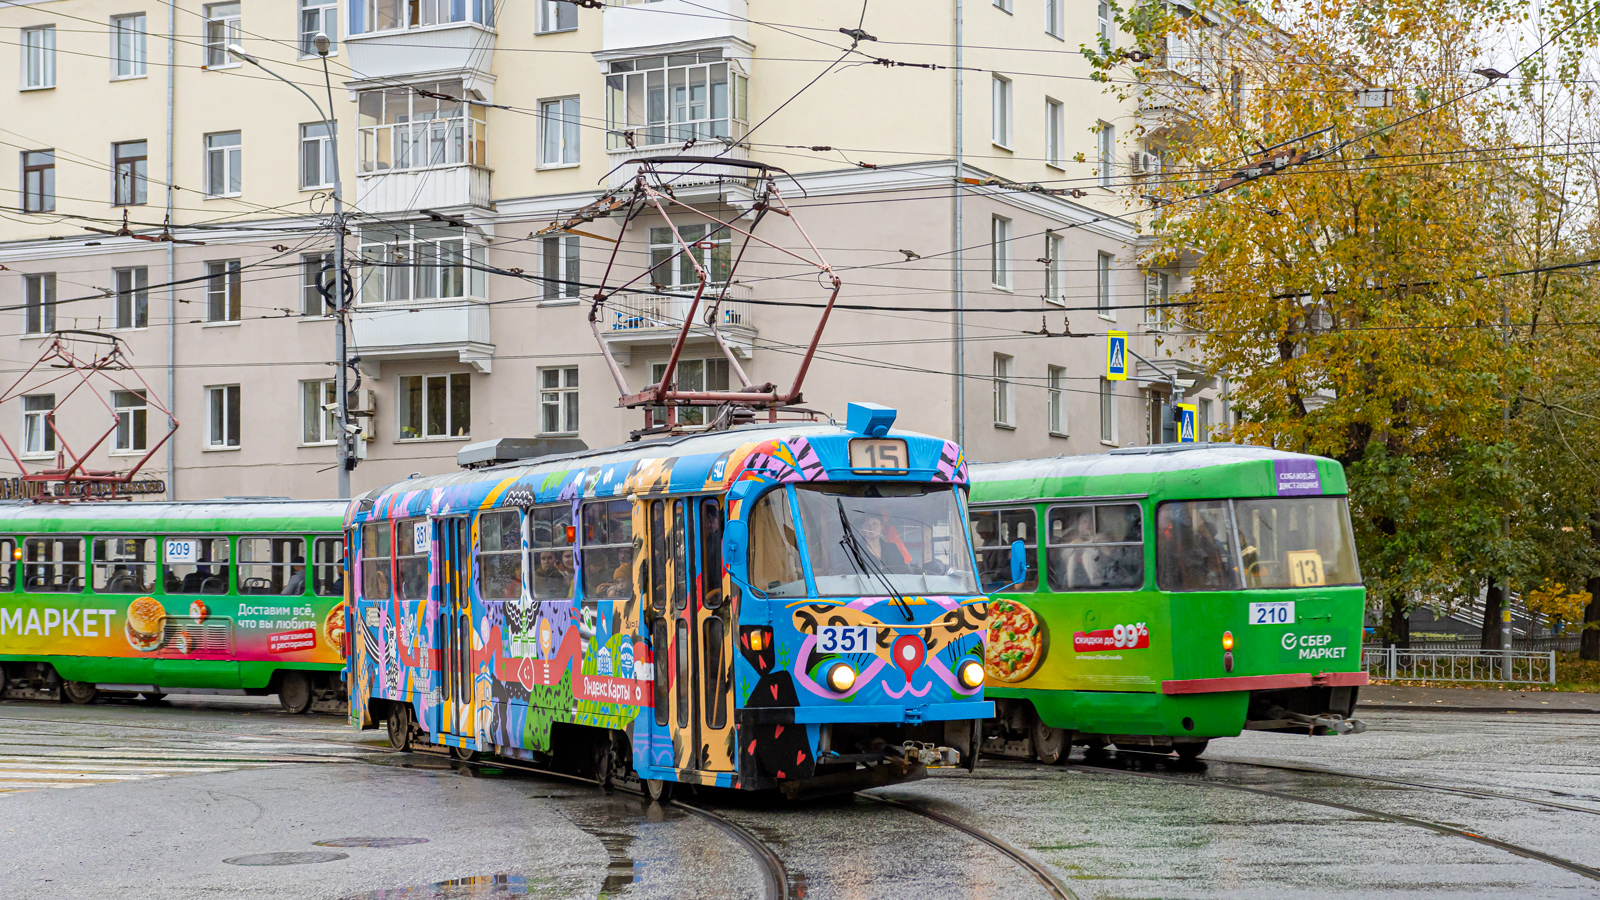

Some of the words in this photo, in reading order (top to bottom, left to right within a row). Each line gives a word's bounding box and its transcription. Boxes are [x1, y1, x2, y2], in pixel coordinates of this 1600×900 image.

[864, 444, 899, 469] 15
[416, 526, 427, 545] 351
[168, 542, 190, 556] 209
[1296, 560, 1319, 584] 13
[238, 603, 291, 616] Доставим
[292, 603, 315, 618] всё,
[1257, 607, 1288, 623] 210
[0, 607, 116, 637] МАРКЕТ
[238, 619, 257, 629] что
[259, 619, 273, 628] вы
[275, 617, 317, 630] любите
[280, 632, 314, 641] магазинов
[822, 627, 869, 651] 351
[1074, 636, 1104, 646] СКИДКИ
[1104, 637, 1115, 646] ДО
[1113, 621, 1148, 648] 99%
[1299, 634, 1332, 647] СБЕР
[276, 640, 314, 651] ресторанов
[1298, 646, 1347, 660] МАРКЕТ
[583, 676, 608, 699] Яндекс
[607, 678, 631, 702] Карты
